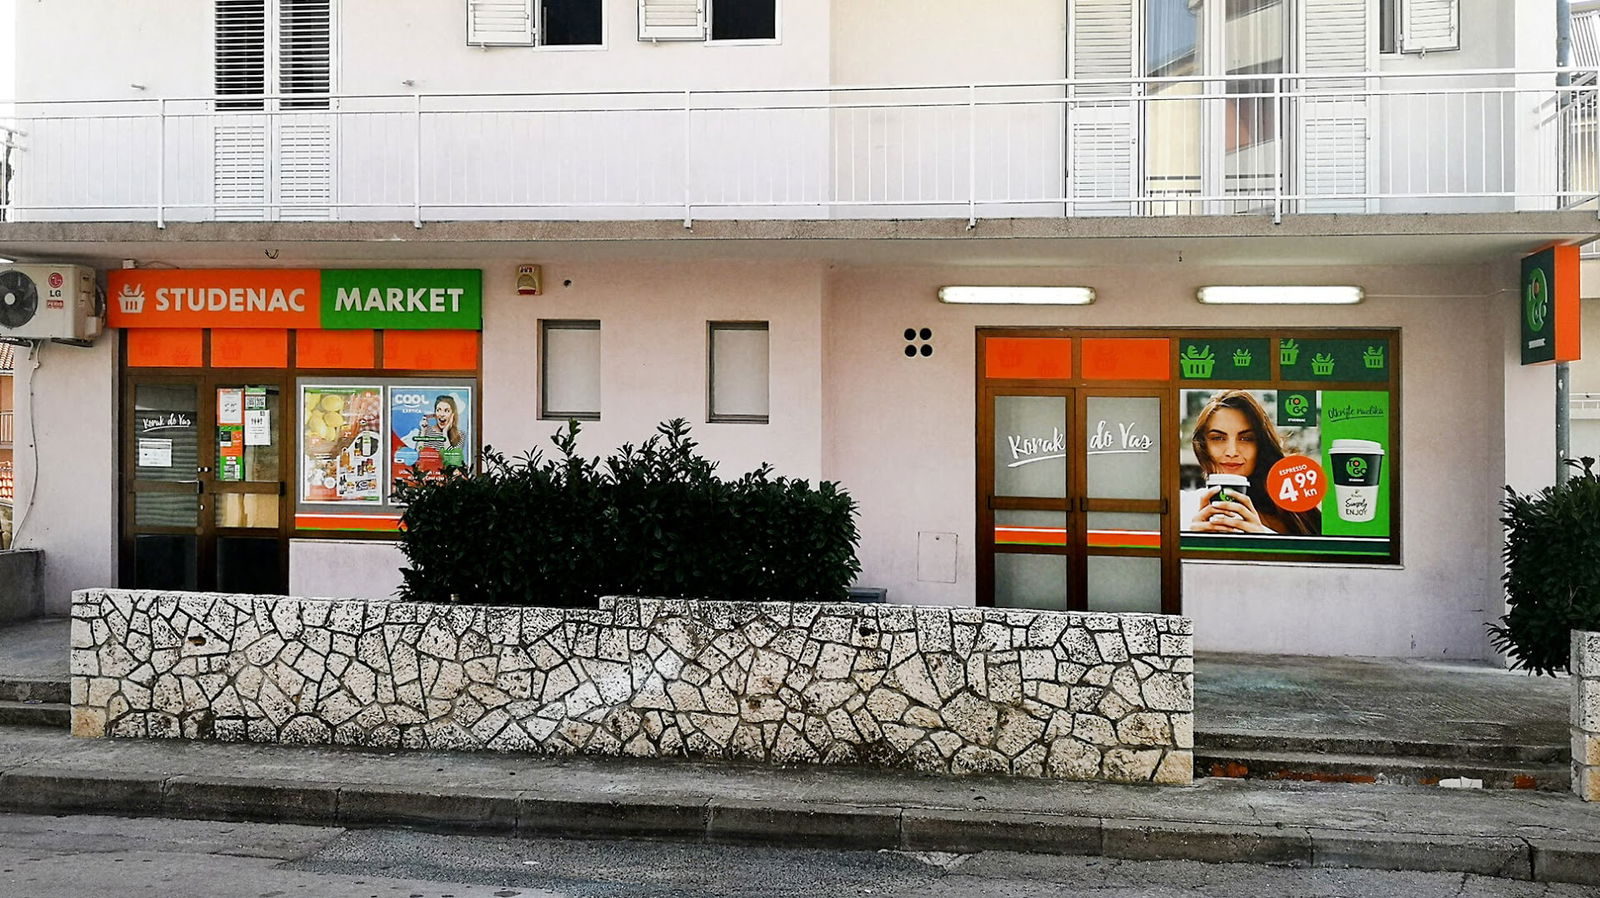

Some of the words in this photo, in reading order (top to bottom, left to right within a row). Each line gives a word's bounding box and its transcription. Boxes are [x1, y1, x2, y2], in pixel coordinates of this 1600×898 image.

[155, 287, 305, 312] STUDENAC
[334, 287, 464, 313] MARKET
[395, 394, 429, 405] COOL
[1293, 406, 1308, 414] GO
[142, 415, 165, 429] Korak
[167, 413, 177, 426] do
[178, 414, 191, 426] Vas
[1008, 427, 1066, 459] Korak
[1090, 420, 1113, 449] do
[1119, 422, 1153, 449] Vas
[1279, 464, 1308, 476] ESPRESSO
[1303, 488, 1317, 498] kn
